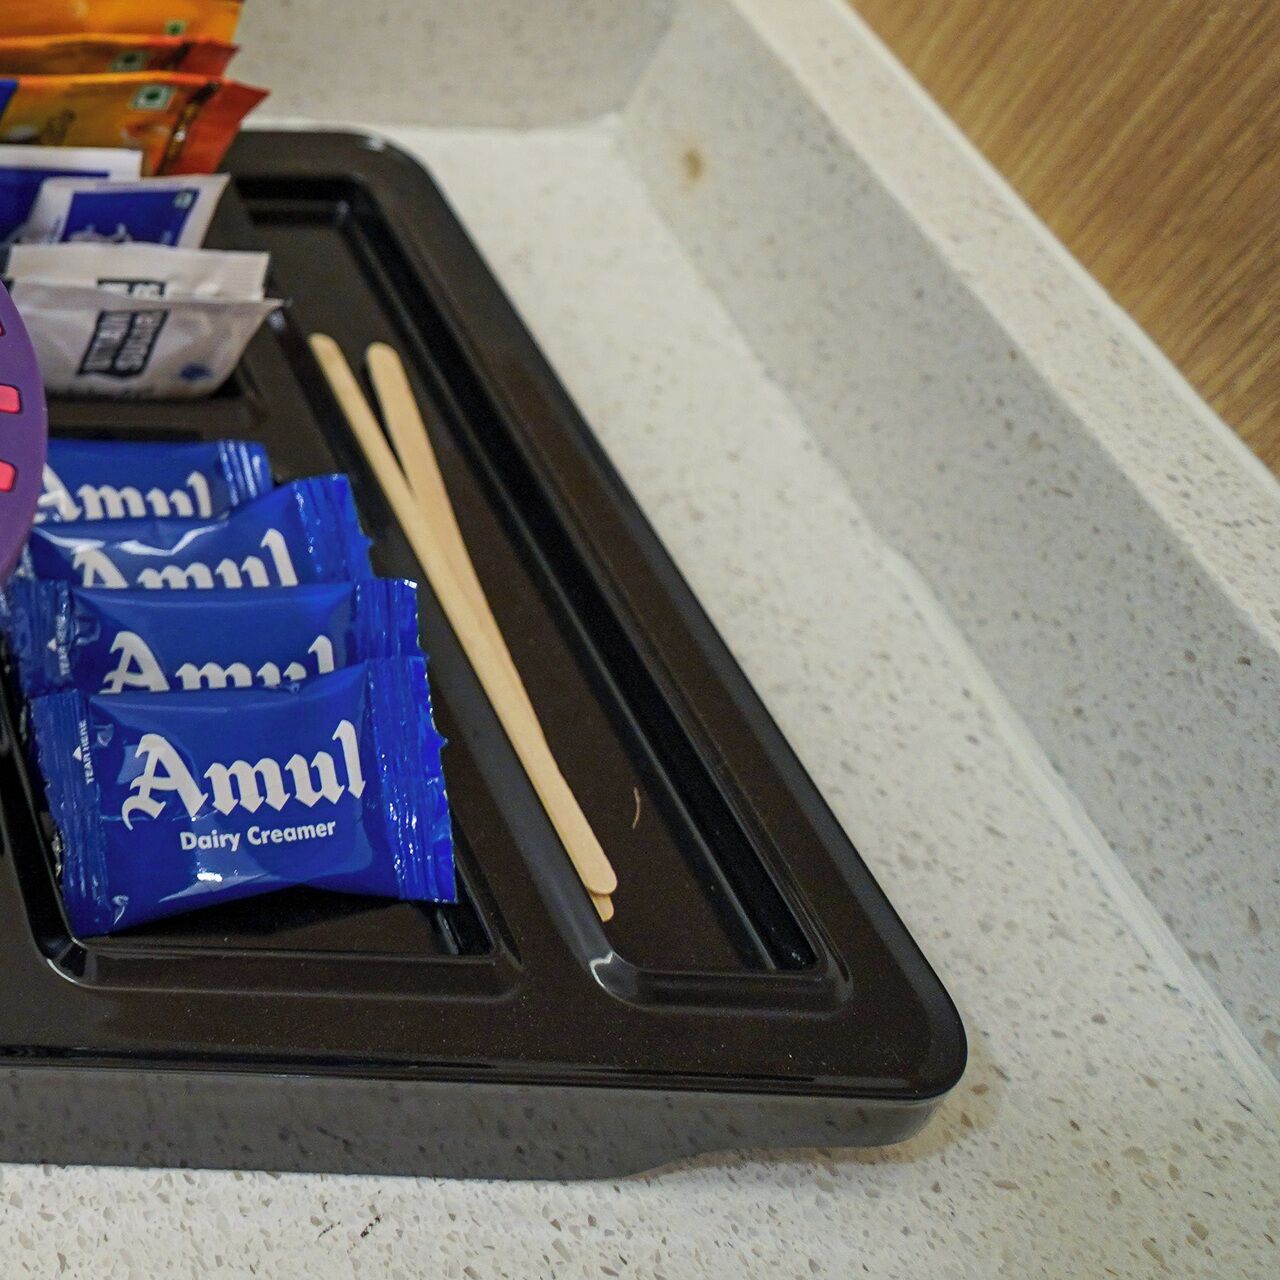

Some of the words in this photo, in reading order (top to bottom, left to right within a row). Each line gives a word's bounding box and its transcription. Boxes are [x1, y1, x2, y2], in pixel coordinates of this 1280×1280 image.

[33, 463, 213, 523] Amul
[81, 752, 95, 785] TEAR
[121, 719, 367, 830] Amul
[180, 831, 240, 852] Dairy
[246, 820, 337, 845] Creamer
